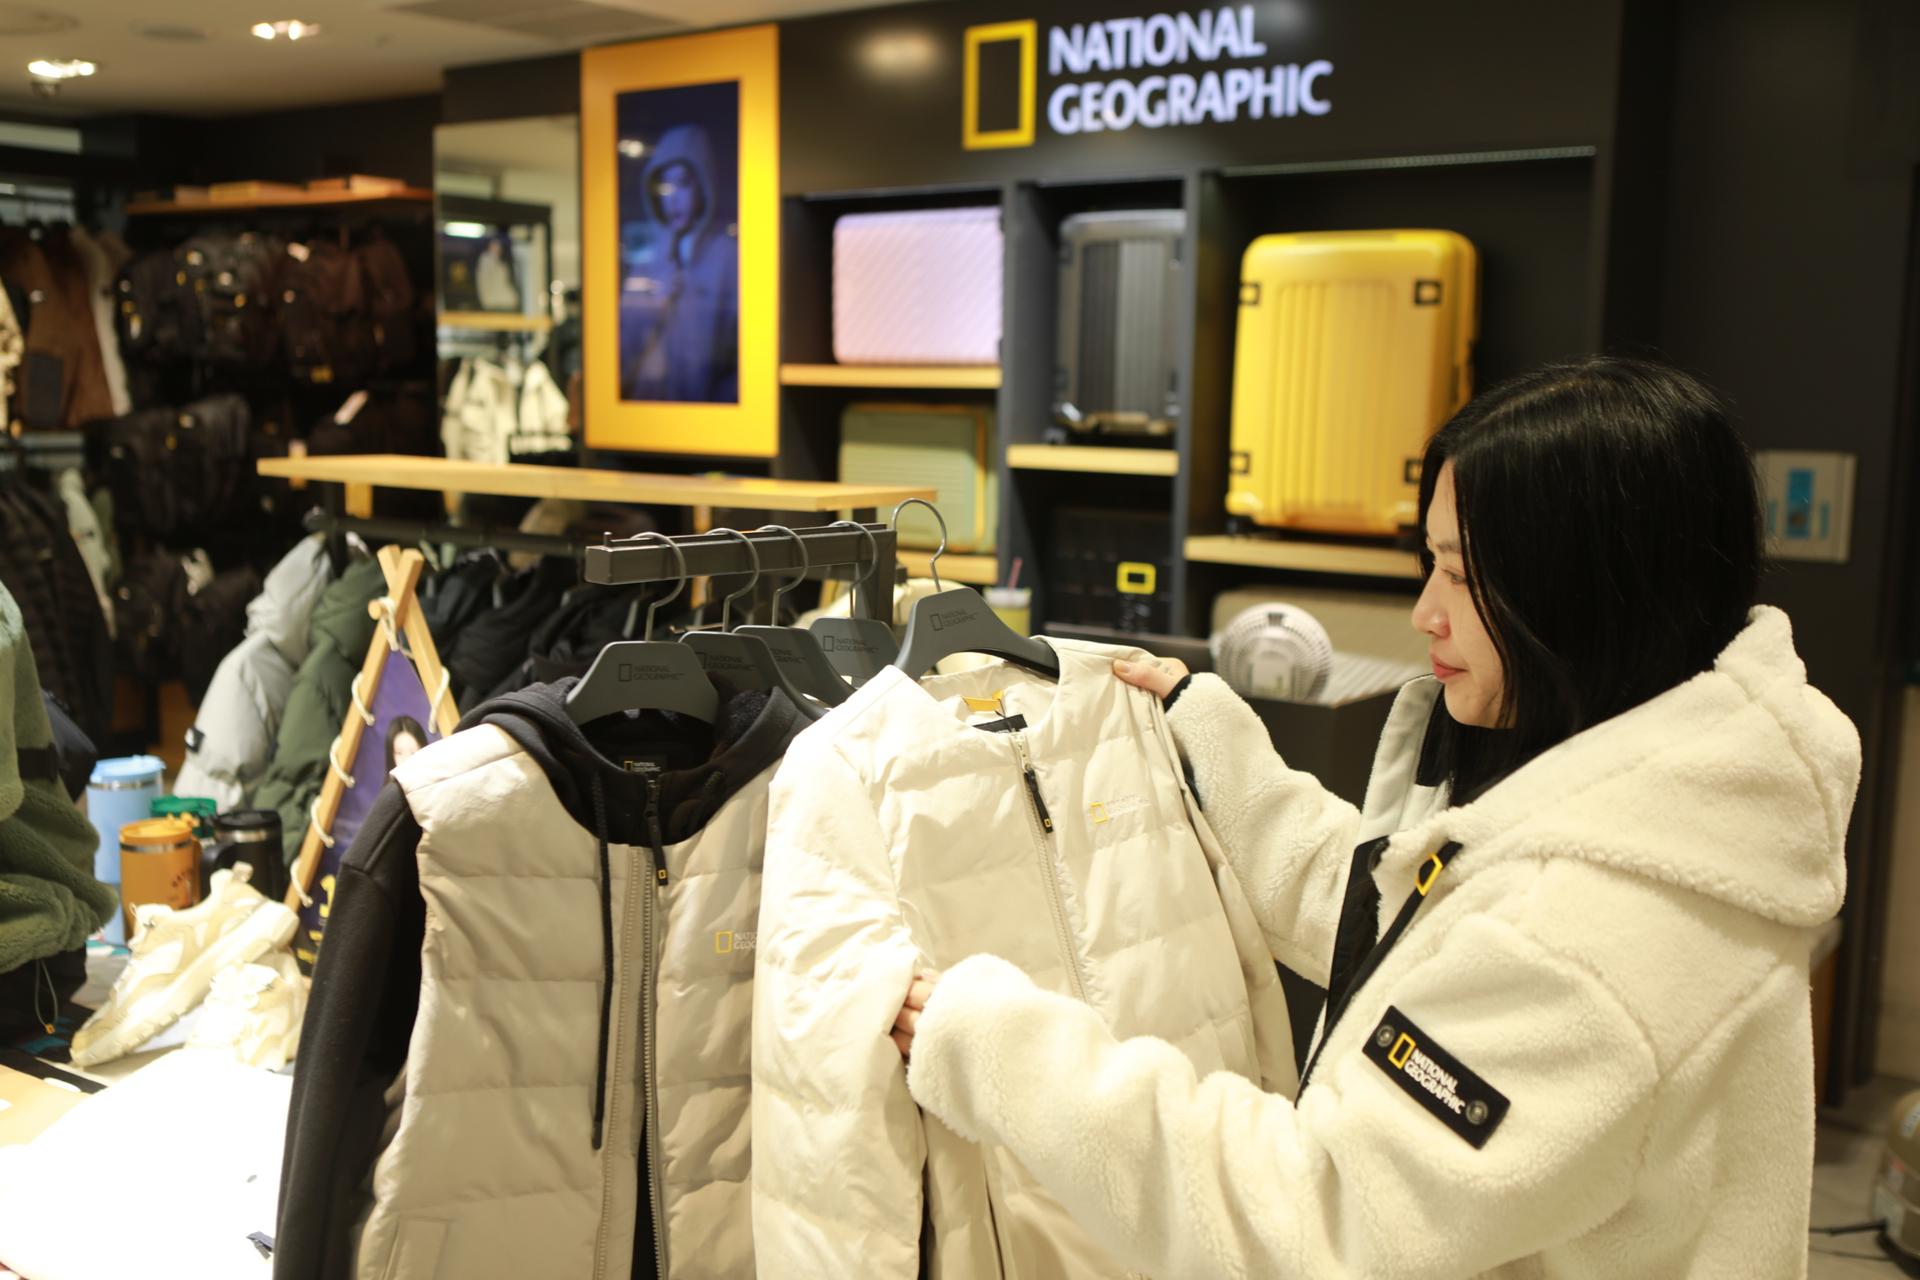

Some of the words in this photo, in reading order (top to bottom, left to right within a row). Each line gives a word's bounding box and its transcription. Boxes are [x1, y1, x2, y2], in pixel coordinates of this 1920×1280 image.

[1047, 5, 1267, 76] NATIONAL
[1047, 60, 1334, 135] GEOGRAPHIC
[1403, 1060, 1467, 1115] GEOGRAPHIC
[1410, 1048, 1459, 1093] NATIONAL
